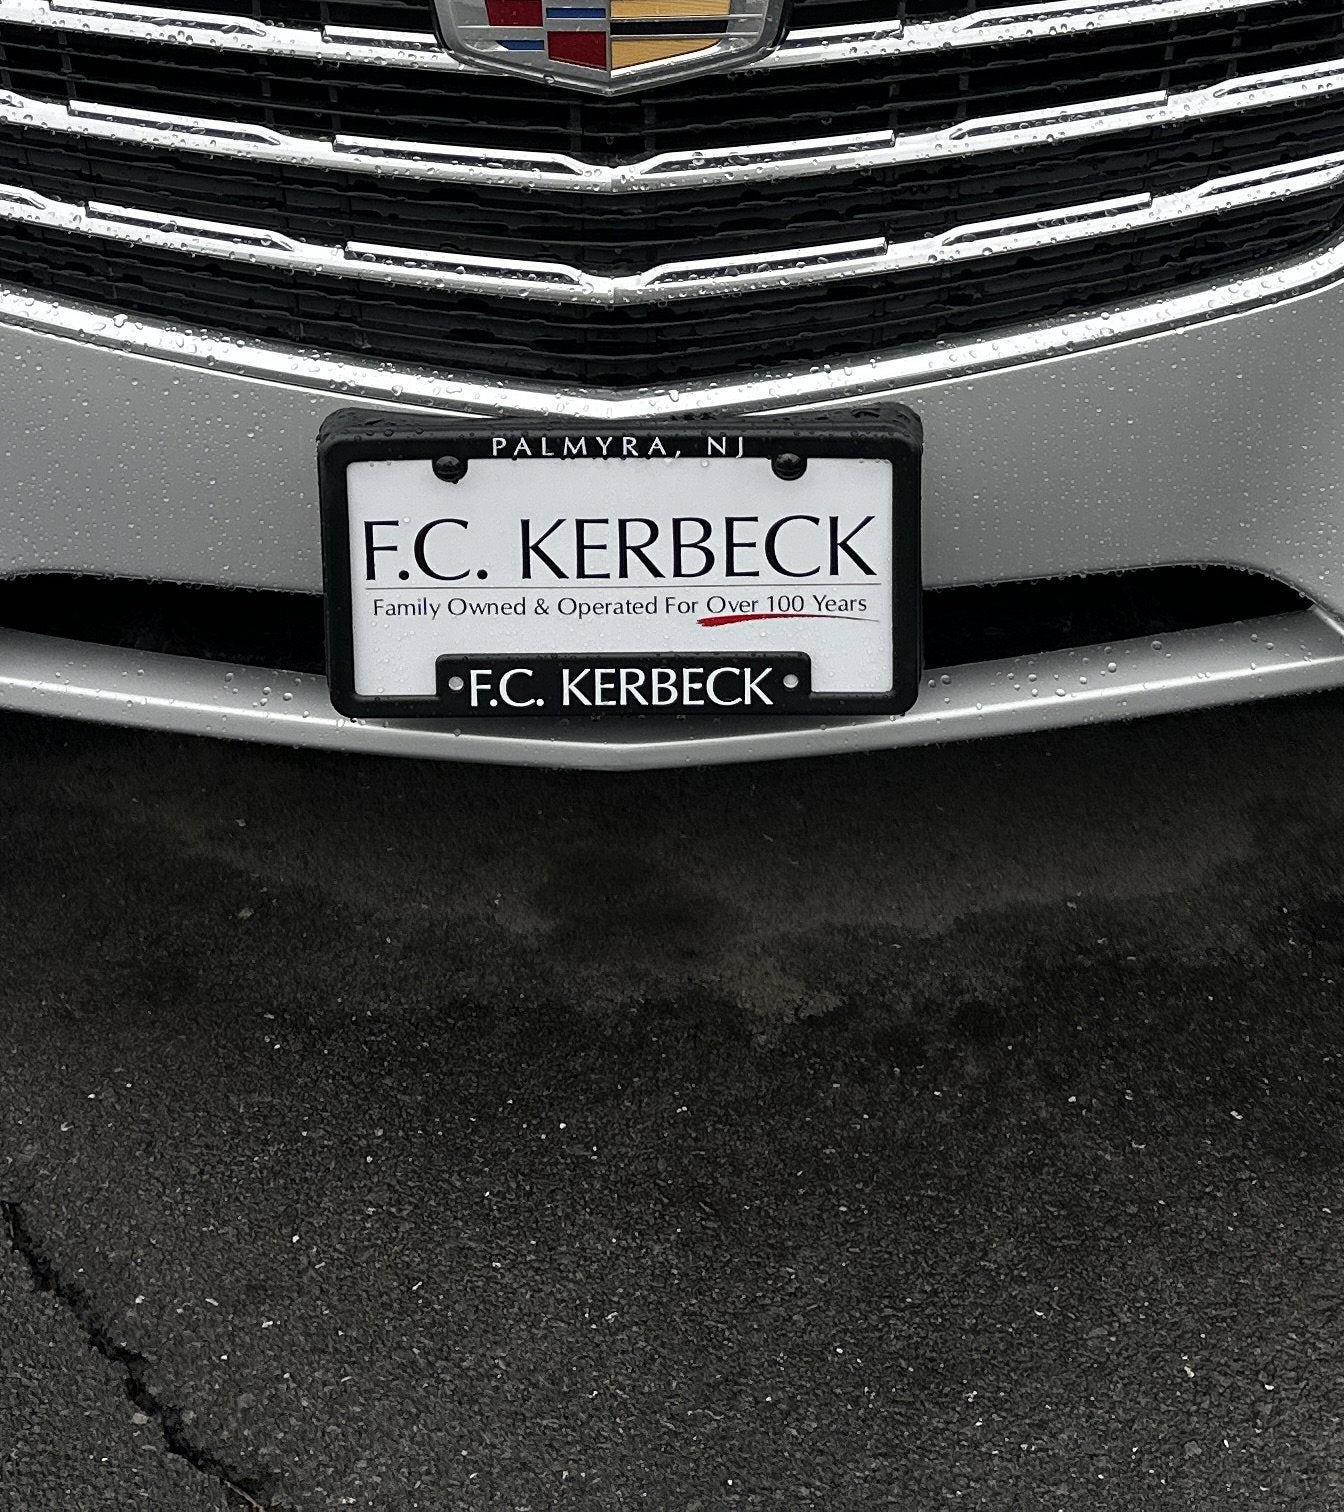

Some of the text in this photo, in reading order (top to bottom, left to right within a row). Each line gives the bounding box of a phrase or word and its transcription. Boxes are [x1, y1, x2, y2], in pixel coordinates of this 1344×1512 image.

[492, 436, 746, 459] PALMYRA, NJ
[364, 514, 878, 582] F.C. KERBECK
[373, 593, 868, 620] Family Owned & Operated For Over 100 Years
[469, 665, 775, 708] F.C. KERBECK
